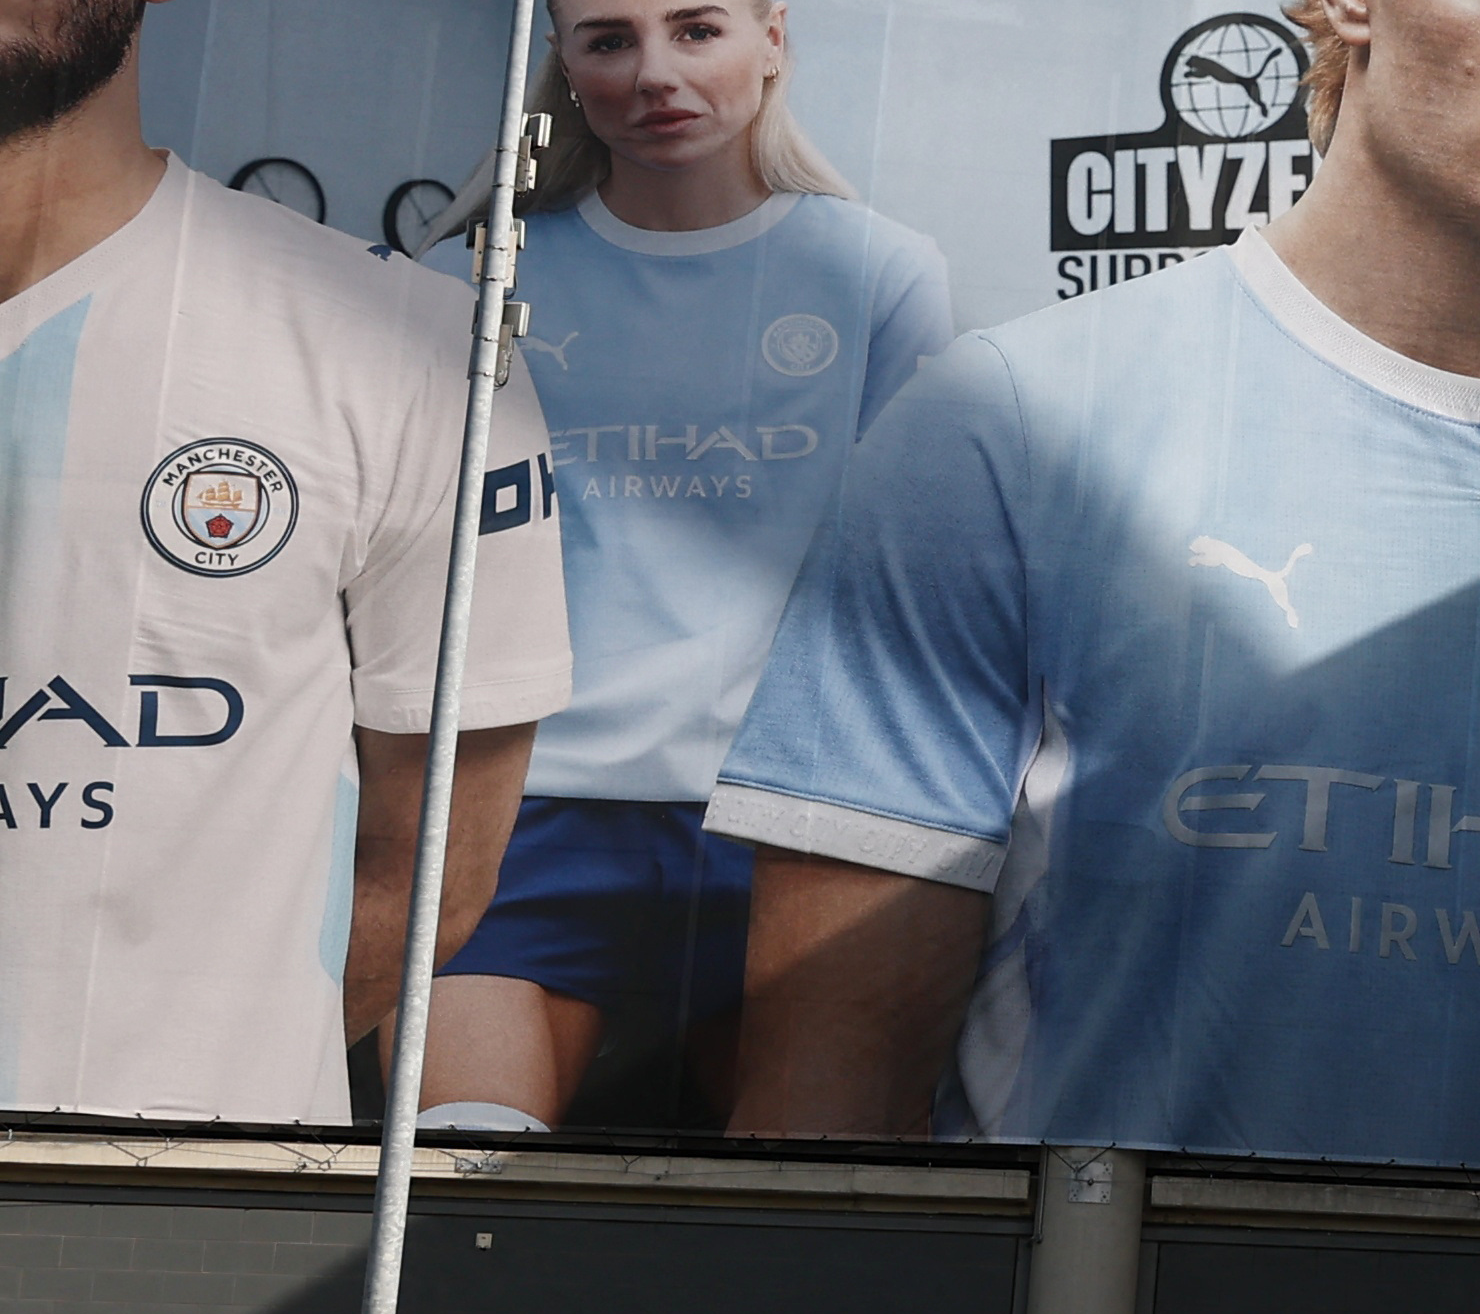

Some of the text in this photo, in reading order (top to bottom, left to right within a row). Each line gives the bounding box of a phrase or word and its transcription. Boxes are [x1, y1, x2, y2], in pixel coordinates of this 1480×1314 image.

[1067, 139, 1320, 236] CITYZE
[1057, 251, 1211, 300] SUP
[162, 447, 284, 494] MANCHESTER
[582, 474, 753, 501] AIRWAYS
[194, 551, 240, 566] CITY
